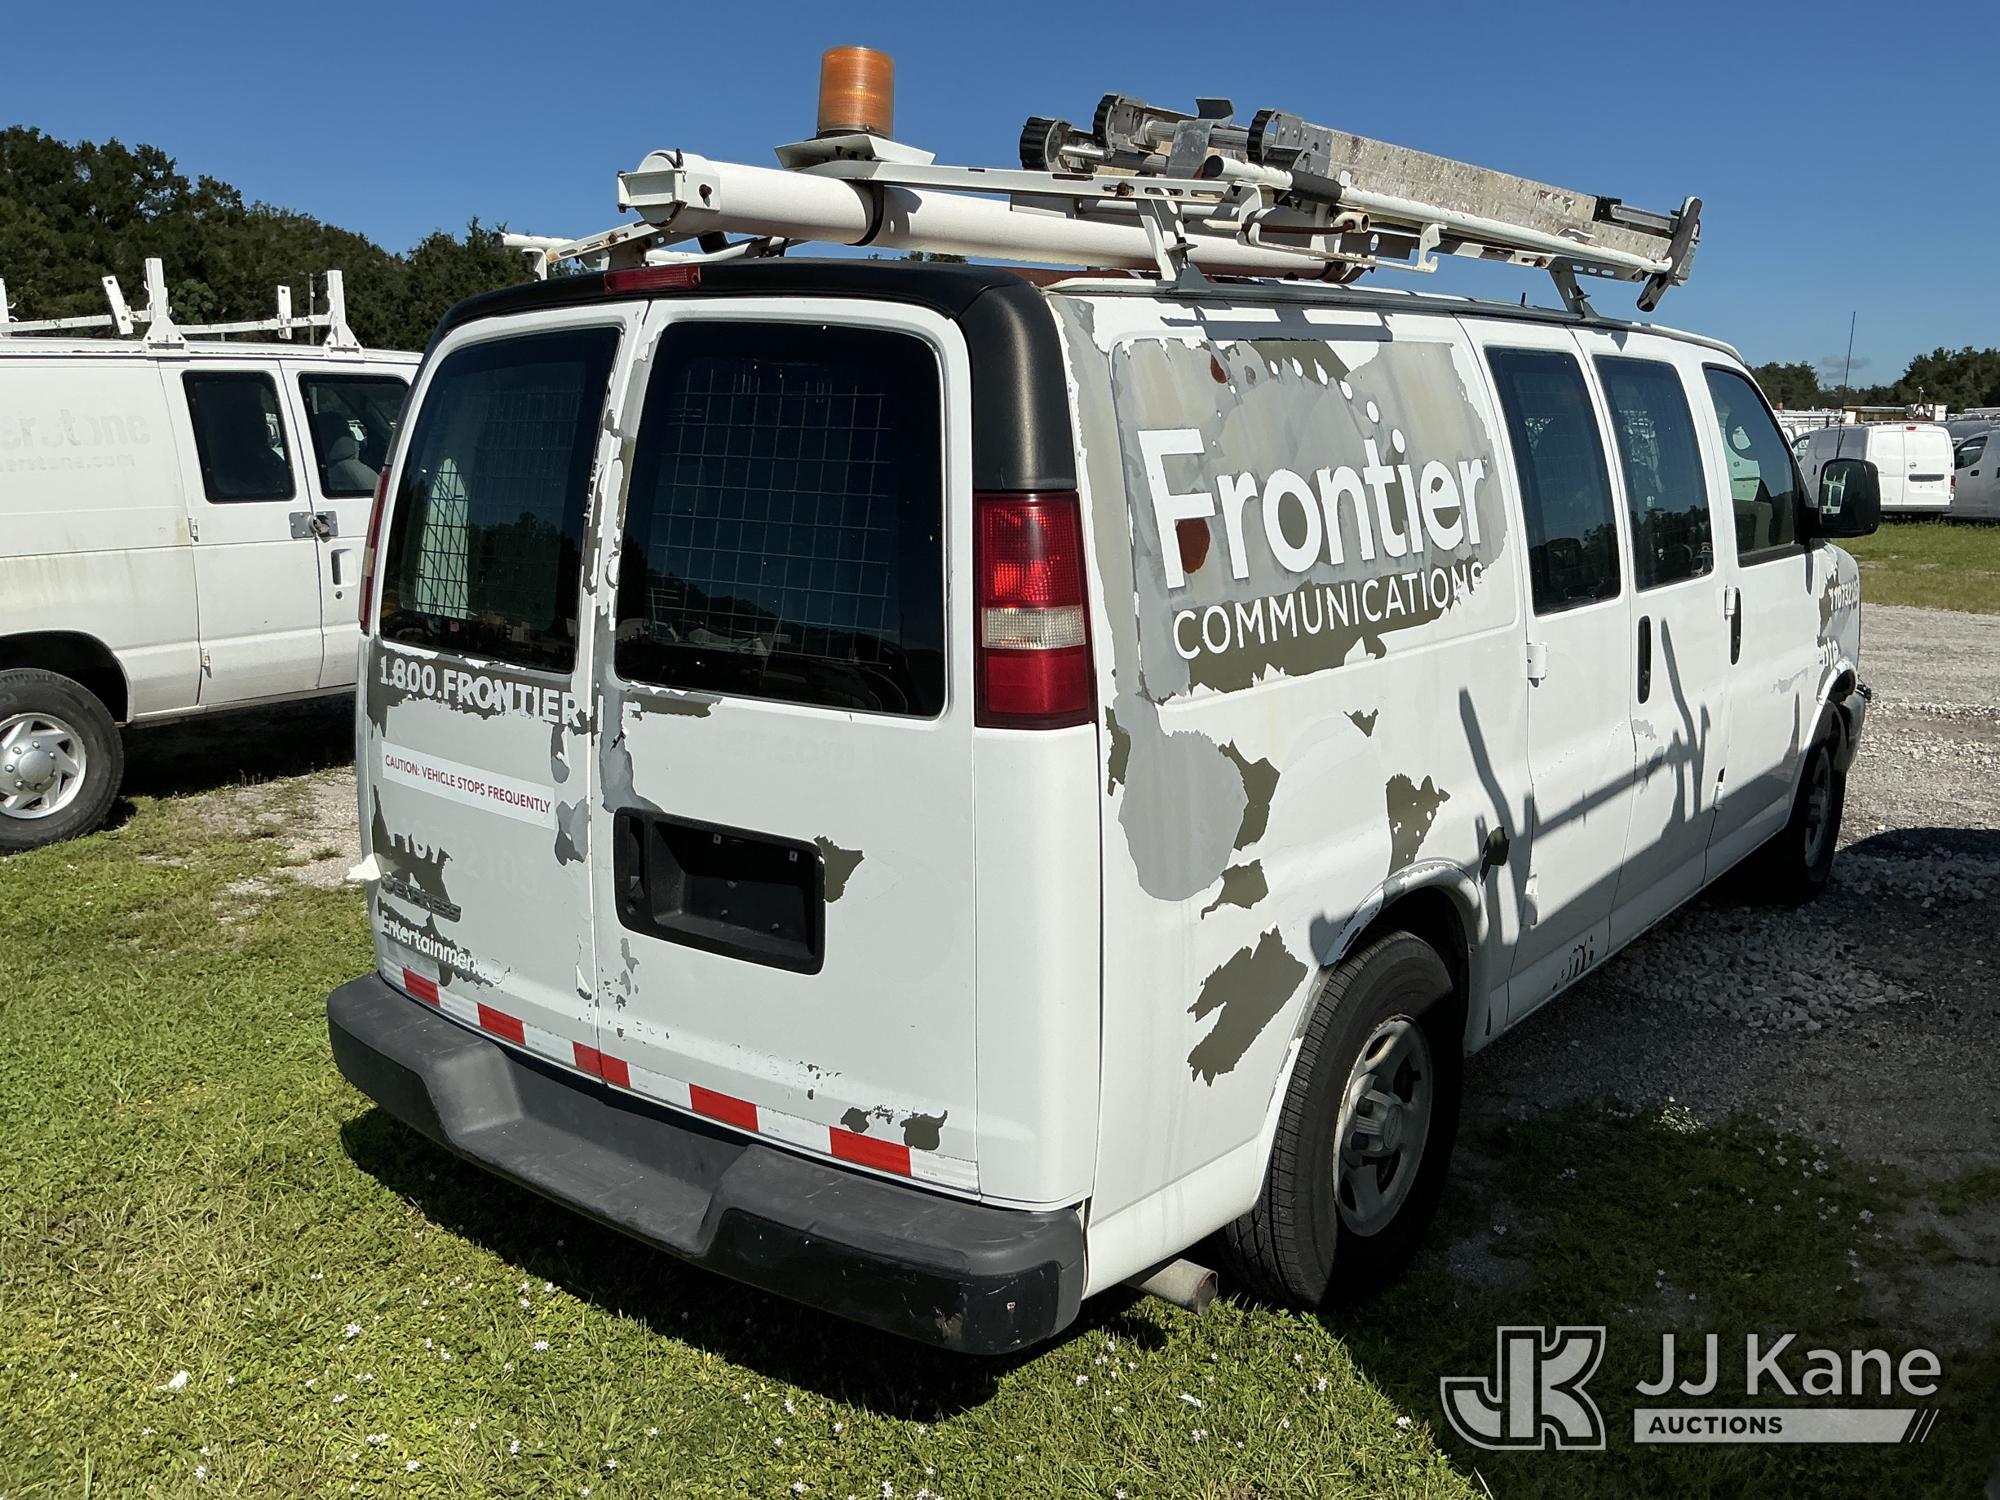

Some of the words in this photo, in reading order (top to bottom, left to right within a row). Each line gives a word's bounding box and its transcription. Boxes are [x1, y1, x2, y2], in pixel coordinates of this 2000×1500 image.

[1137, 428, 1485, 589] Frontier
[385, 754, 420, 776] CAUTION:
[422, 766, 455, 787] VEHICLE
[457, 777, 486, 796] STOPS
[487, 785, 551, 814] FREQUENTLY
[381, 910, 483, 974] Entertainmen
